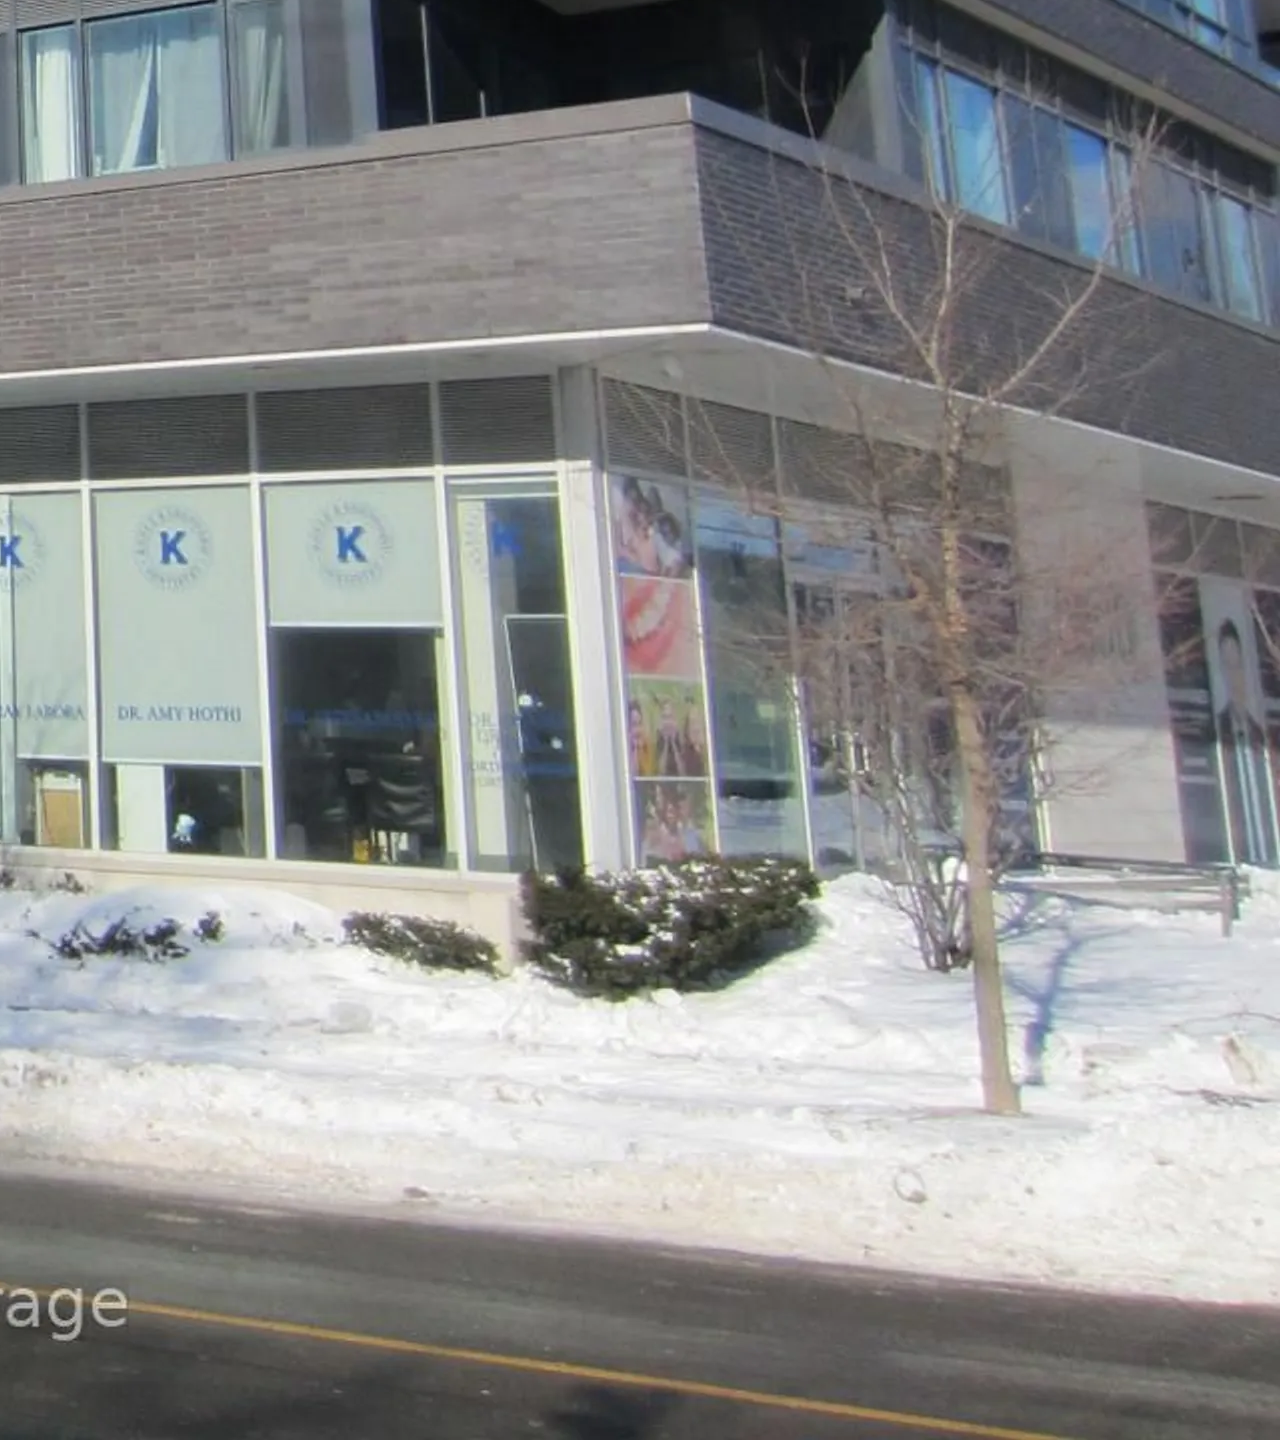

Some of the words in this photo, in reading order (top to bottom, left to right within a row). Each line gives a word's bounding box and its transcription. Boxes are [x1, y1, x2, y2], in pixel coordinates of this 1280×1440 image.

[160, 531, 188, 565] K
[336, 526, 367, 563] K
[117, 706, 142, 721] DR.
[147, 706, 182, 722] AMY
